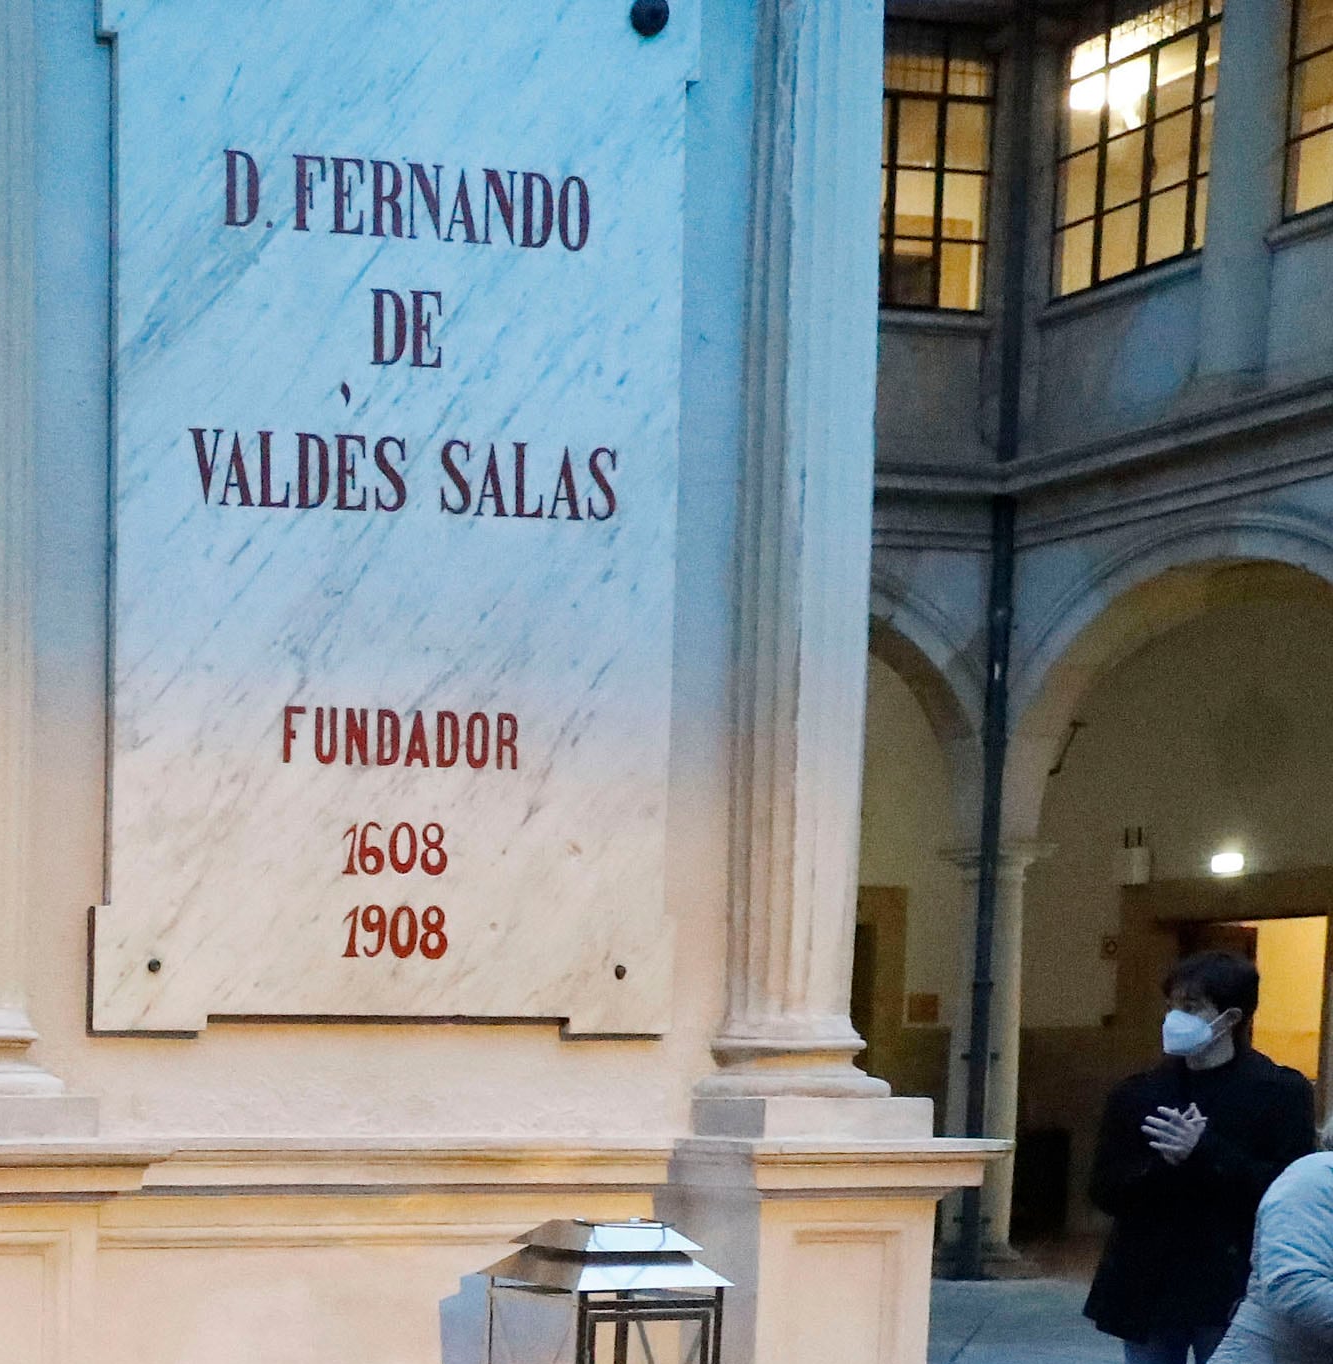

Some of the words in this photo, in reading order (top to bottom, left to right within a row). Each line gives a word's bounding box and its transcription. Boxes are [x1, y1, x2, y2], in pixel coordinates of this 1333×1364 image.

[223, 149, 274, 229] D.
[292, 153, 590, 252] FERNANDO
[370, 288, 443, 369] DE
[440, 438, 618, 521] SALAS
[282, 705, 518, 770] FUNDADOR
[342, 821, 448, 876] 1608
[342, 904, 448, 960] 1908
